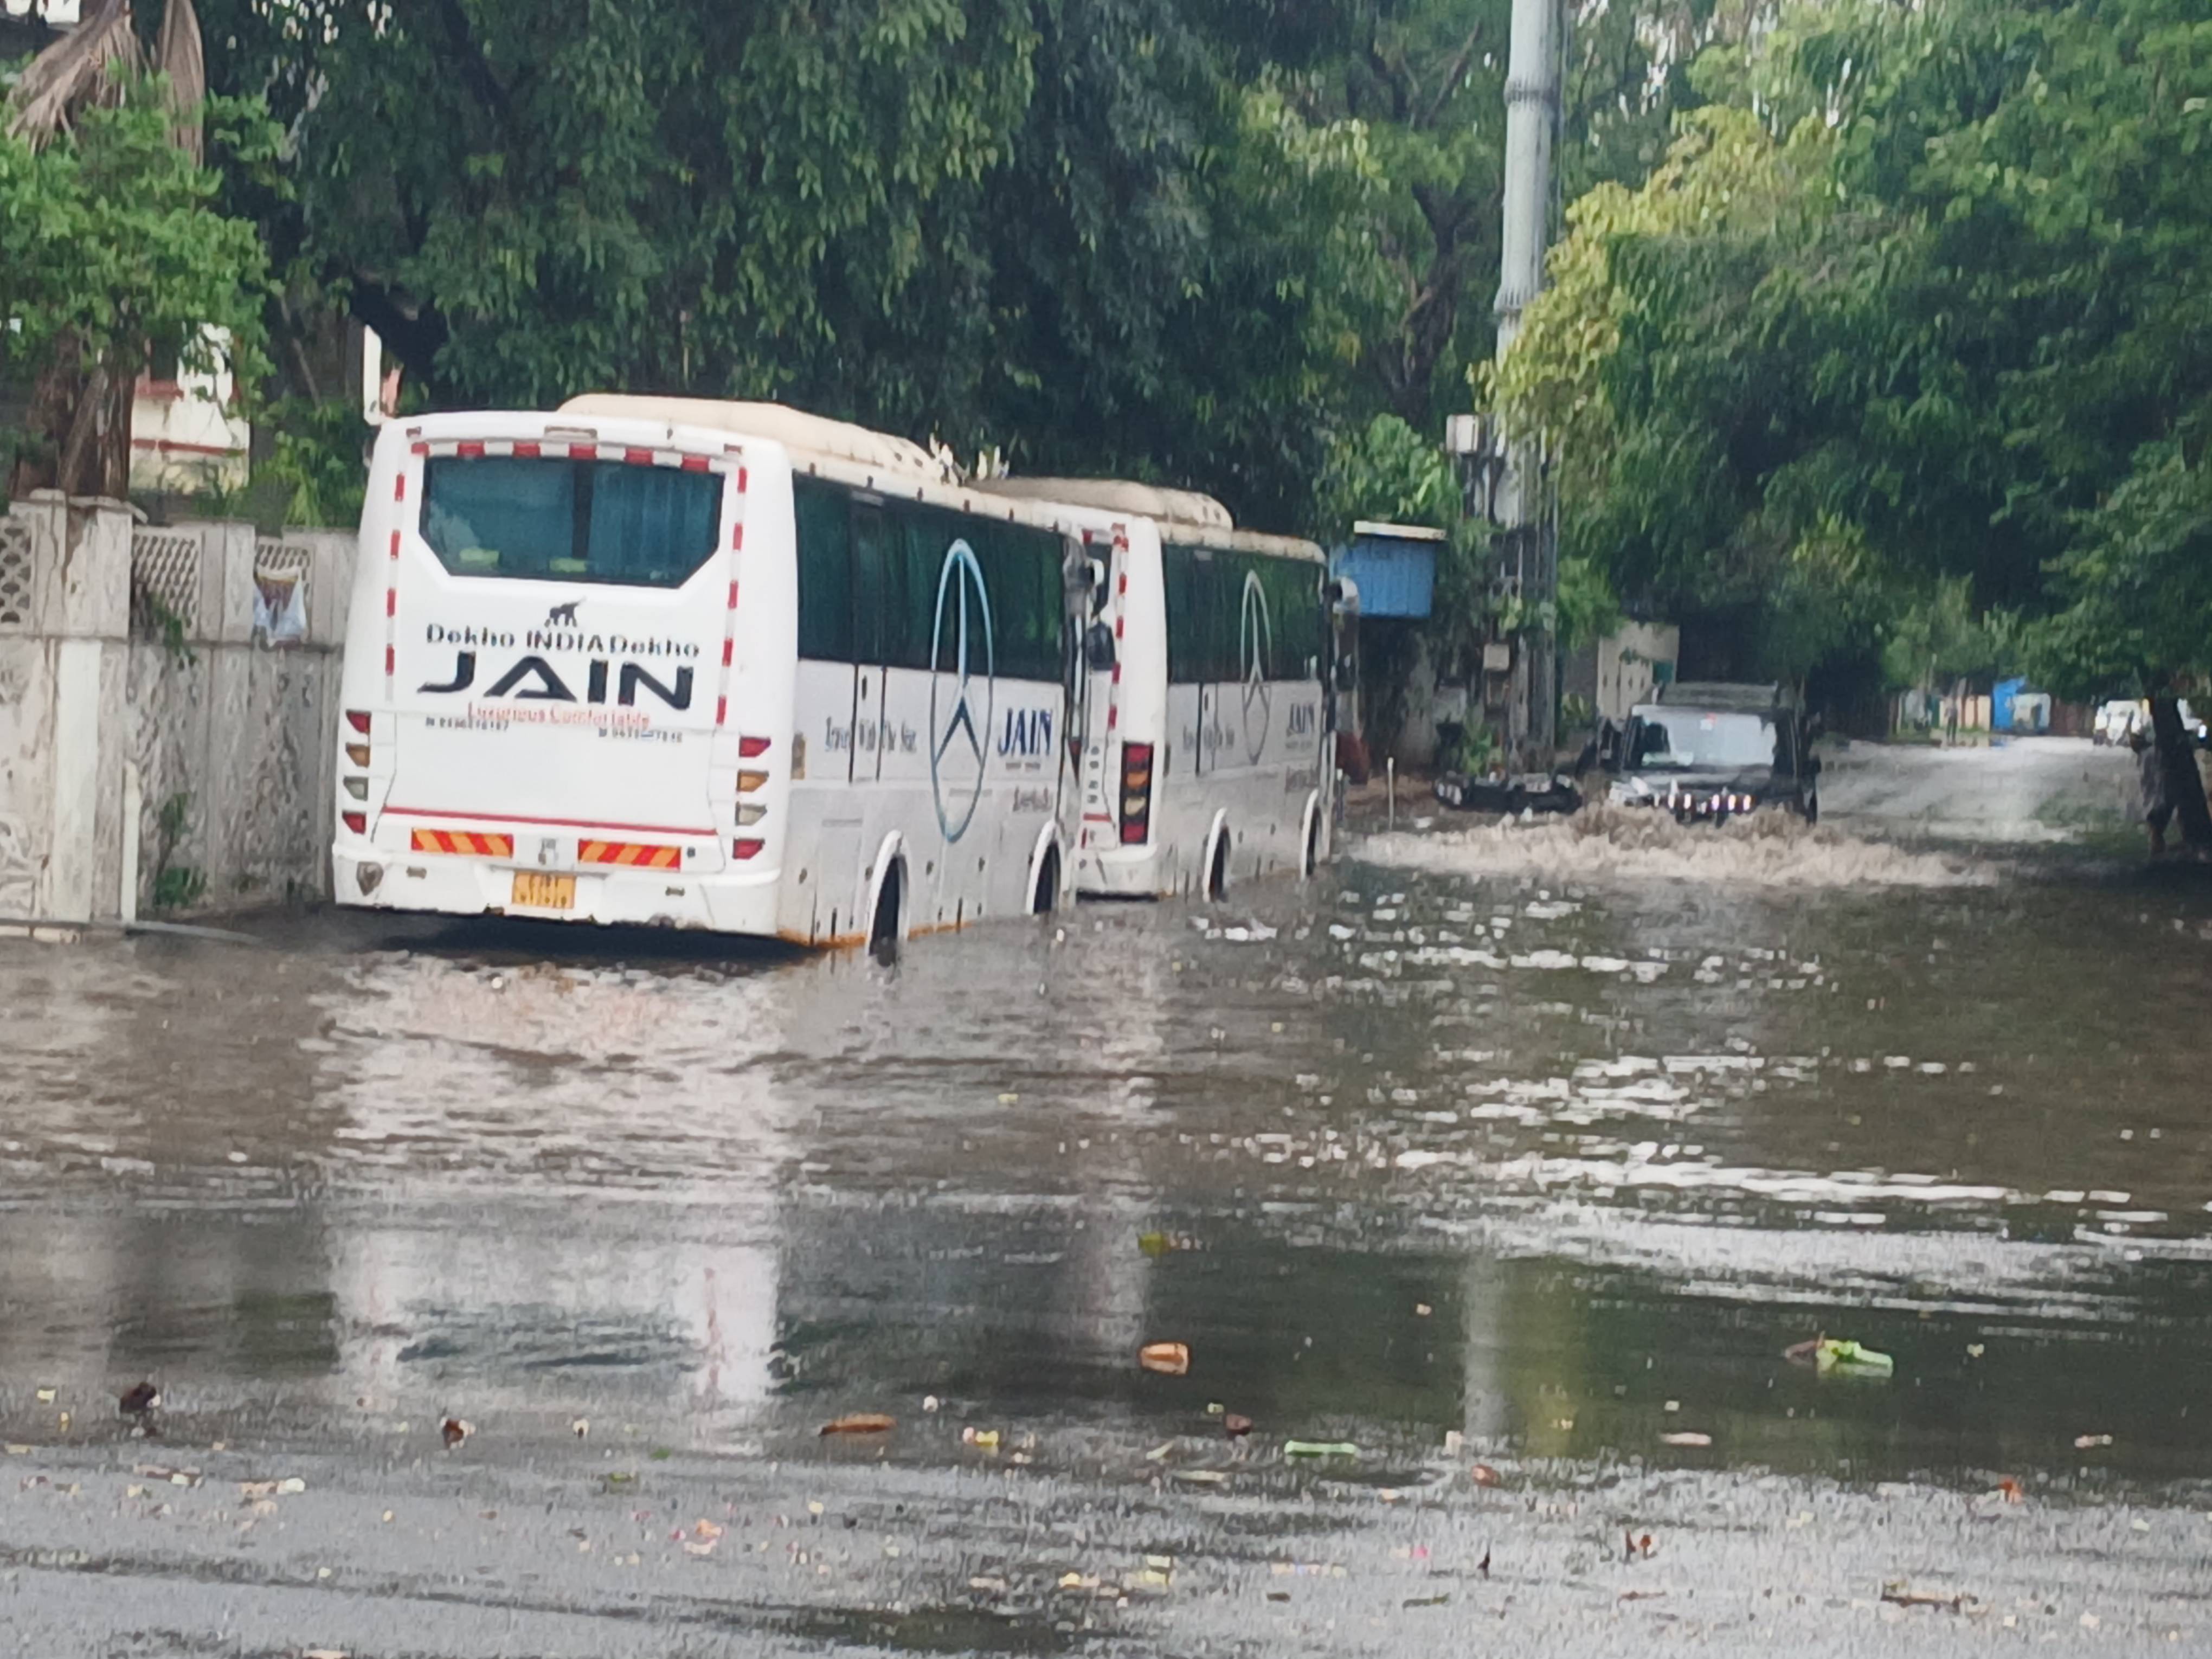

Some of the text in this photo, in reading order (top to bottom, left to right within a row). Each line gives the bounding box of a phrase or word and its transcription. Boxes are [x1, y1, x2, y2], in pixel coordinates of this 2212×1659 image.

[526, 629, 604, 654] INDIA
[416, 650, 694, 711] JAIN
[997, 707, 1054, 756] JAIN
